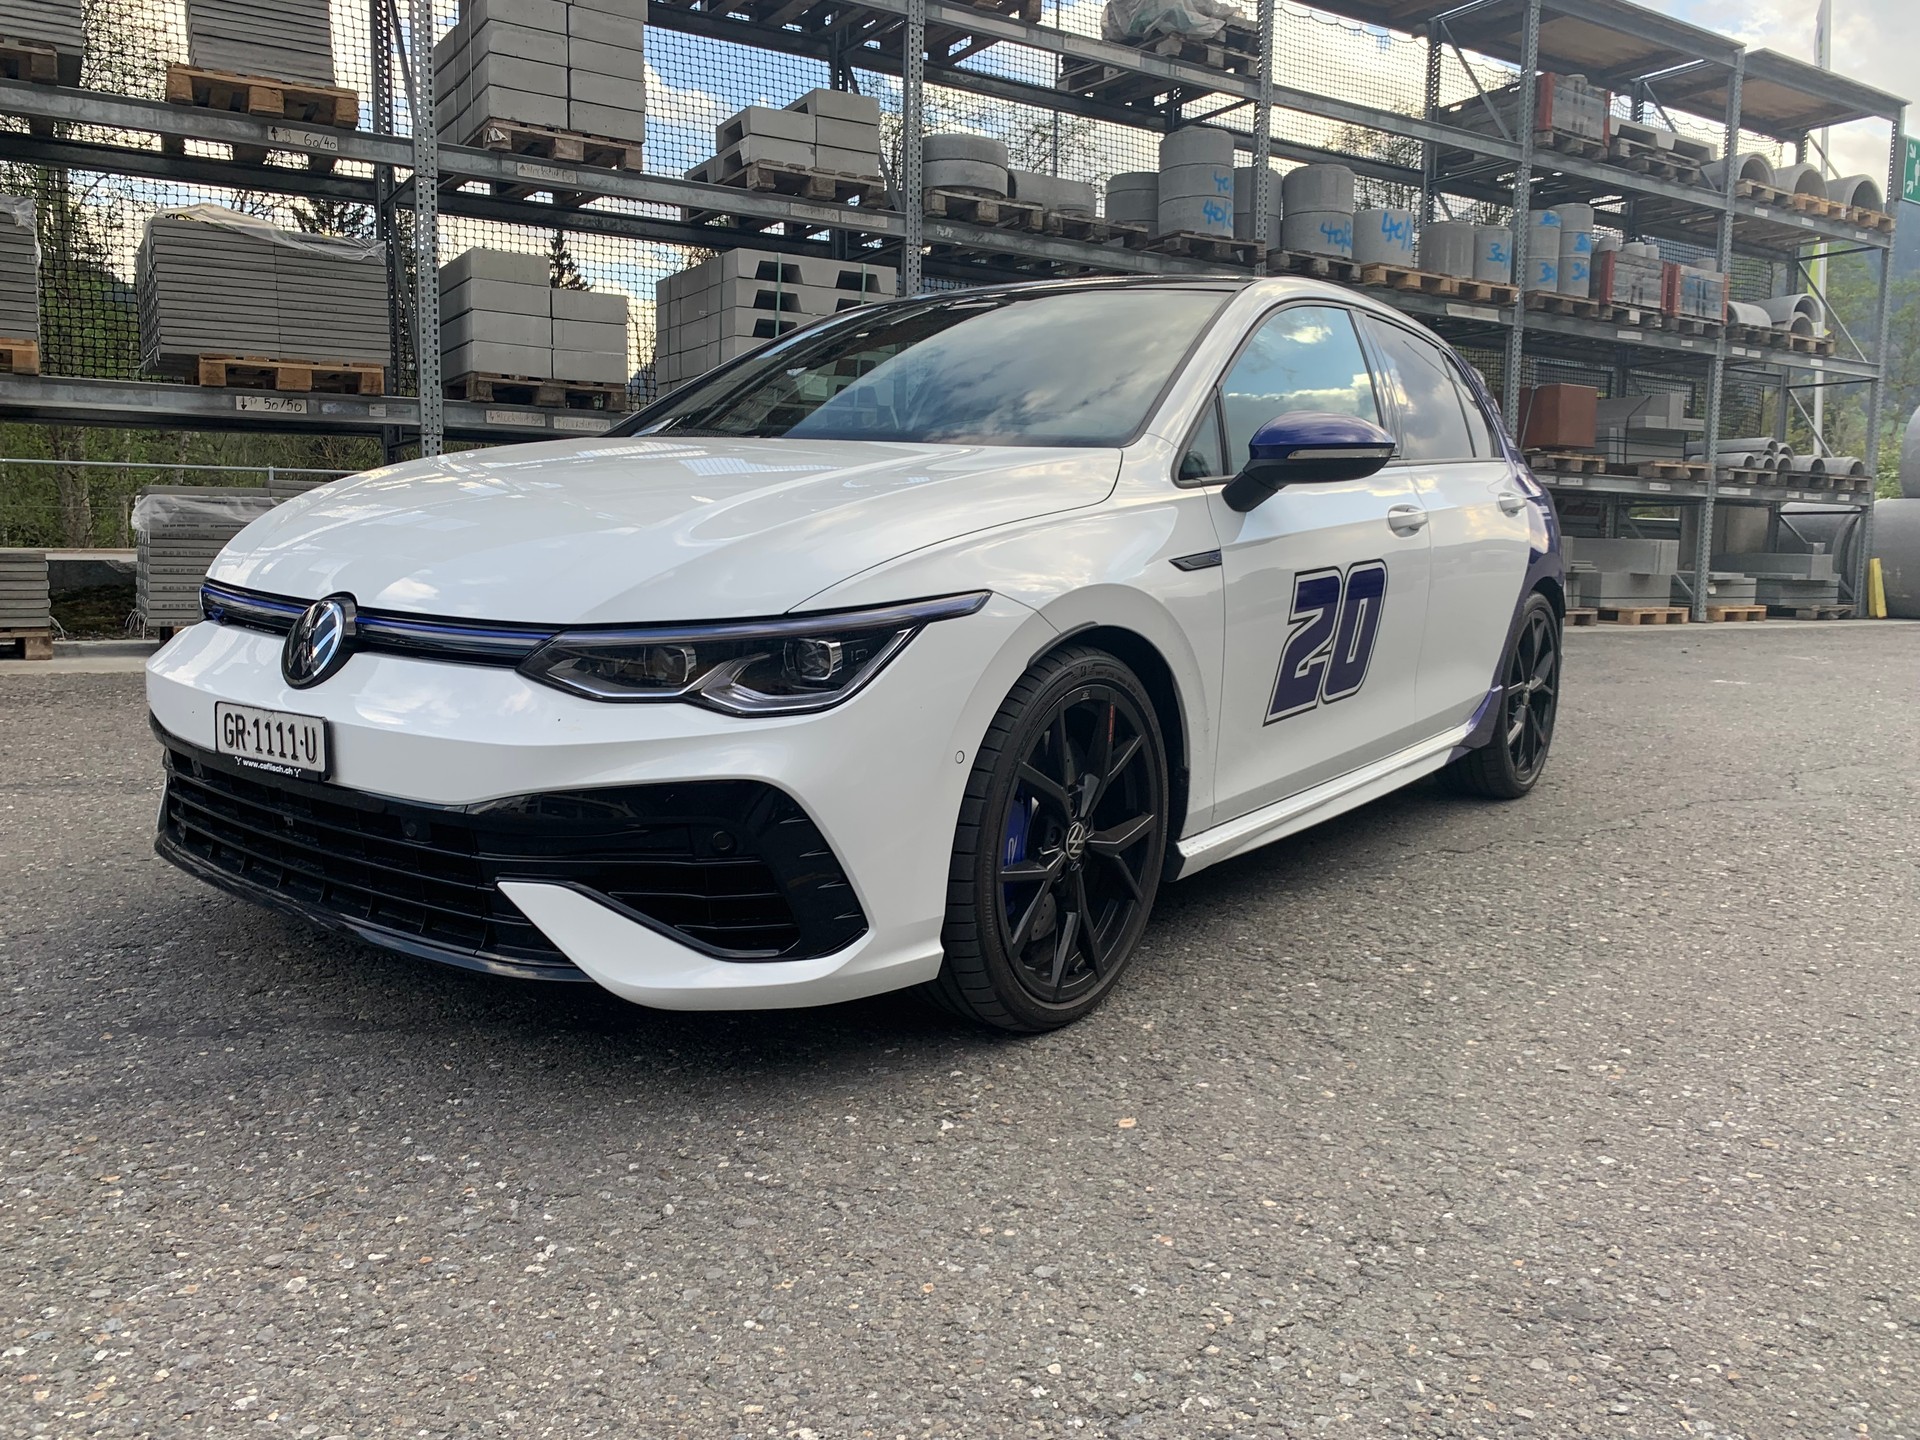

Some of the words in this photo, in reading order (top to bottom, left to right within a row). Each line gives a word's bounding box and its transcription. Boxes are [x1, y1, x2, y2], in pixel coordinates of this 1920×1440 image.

[304, 133, 337, 149] 60/40
[264, 397, 303, 412] 50/50
[1263, 558, 1388, 727] 20
